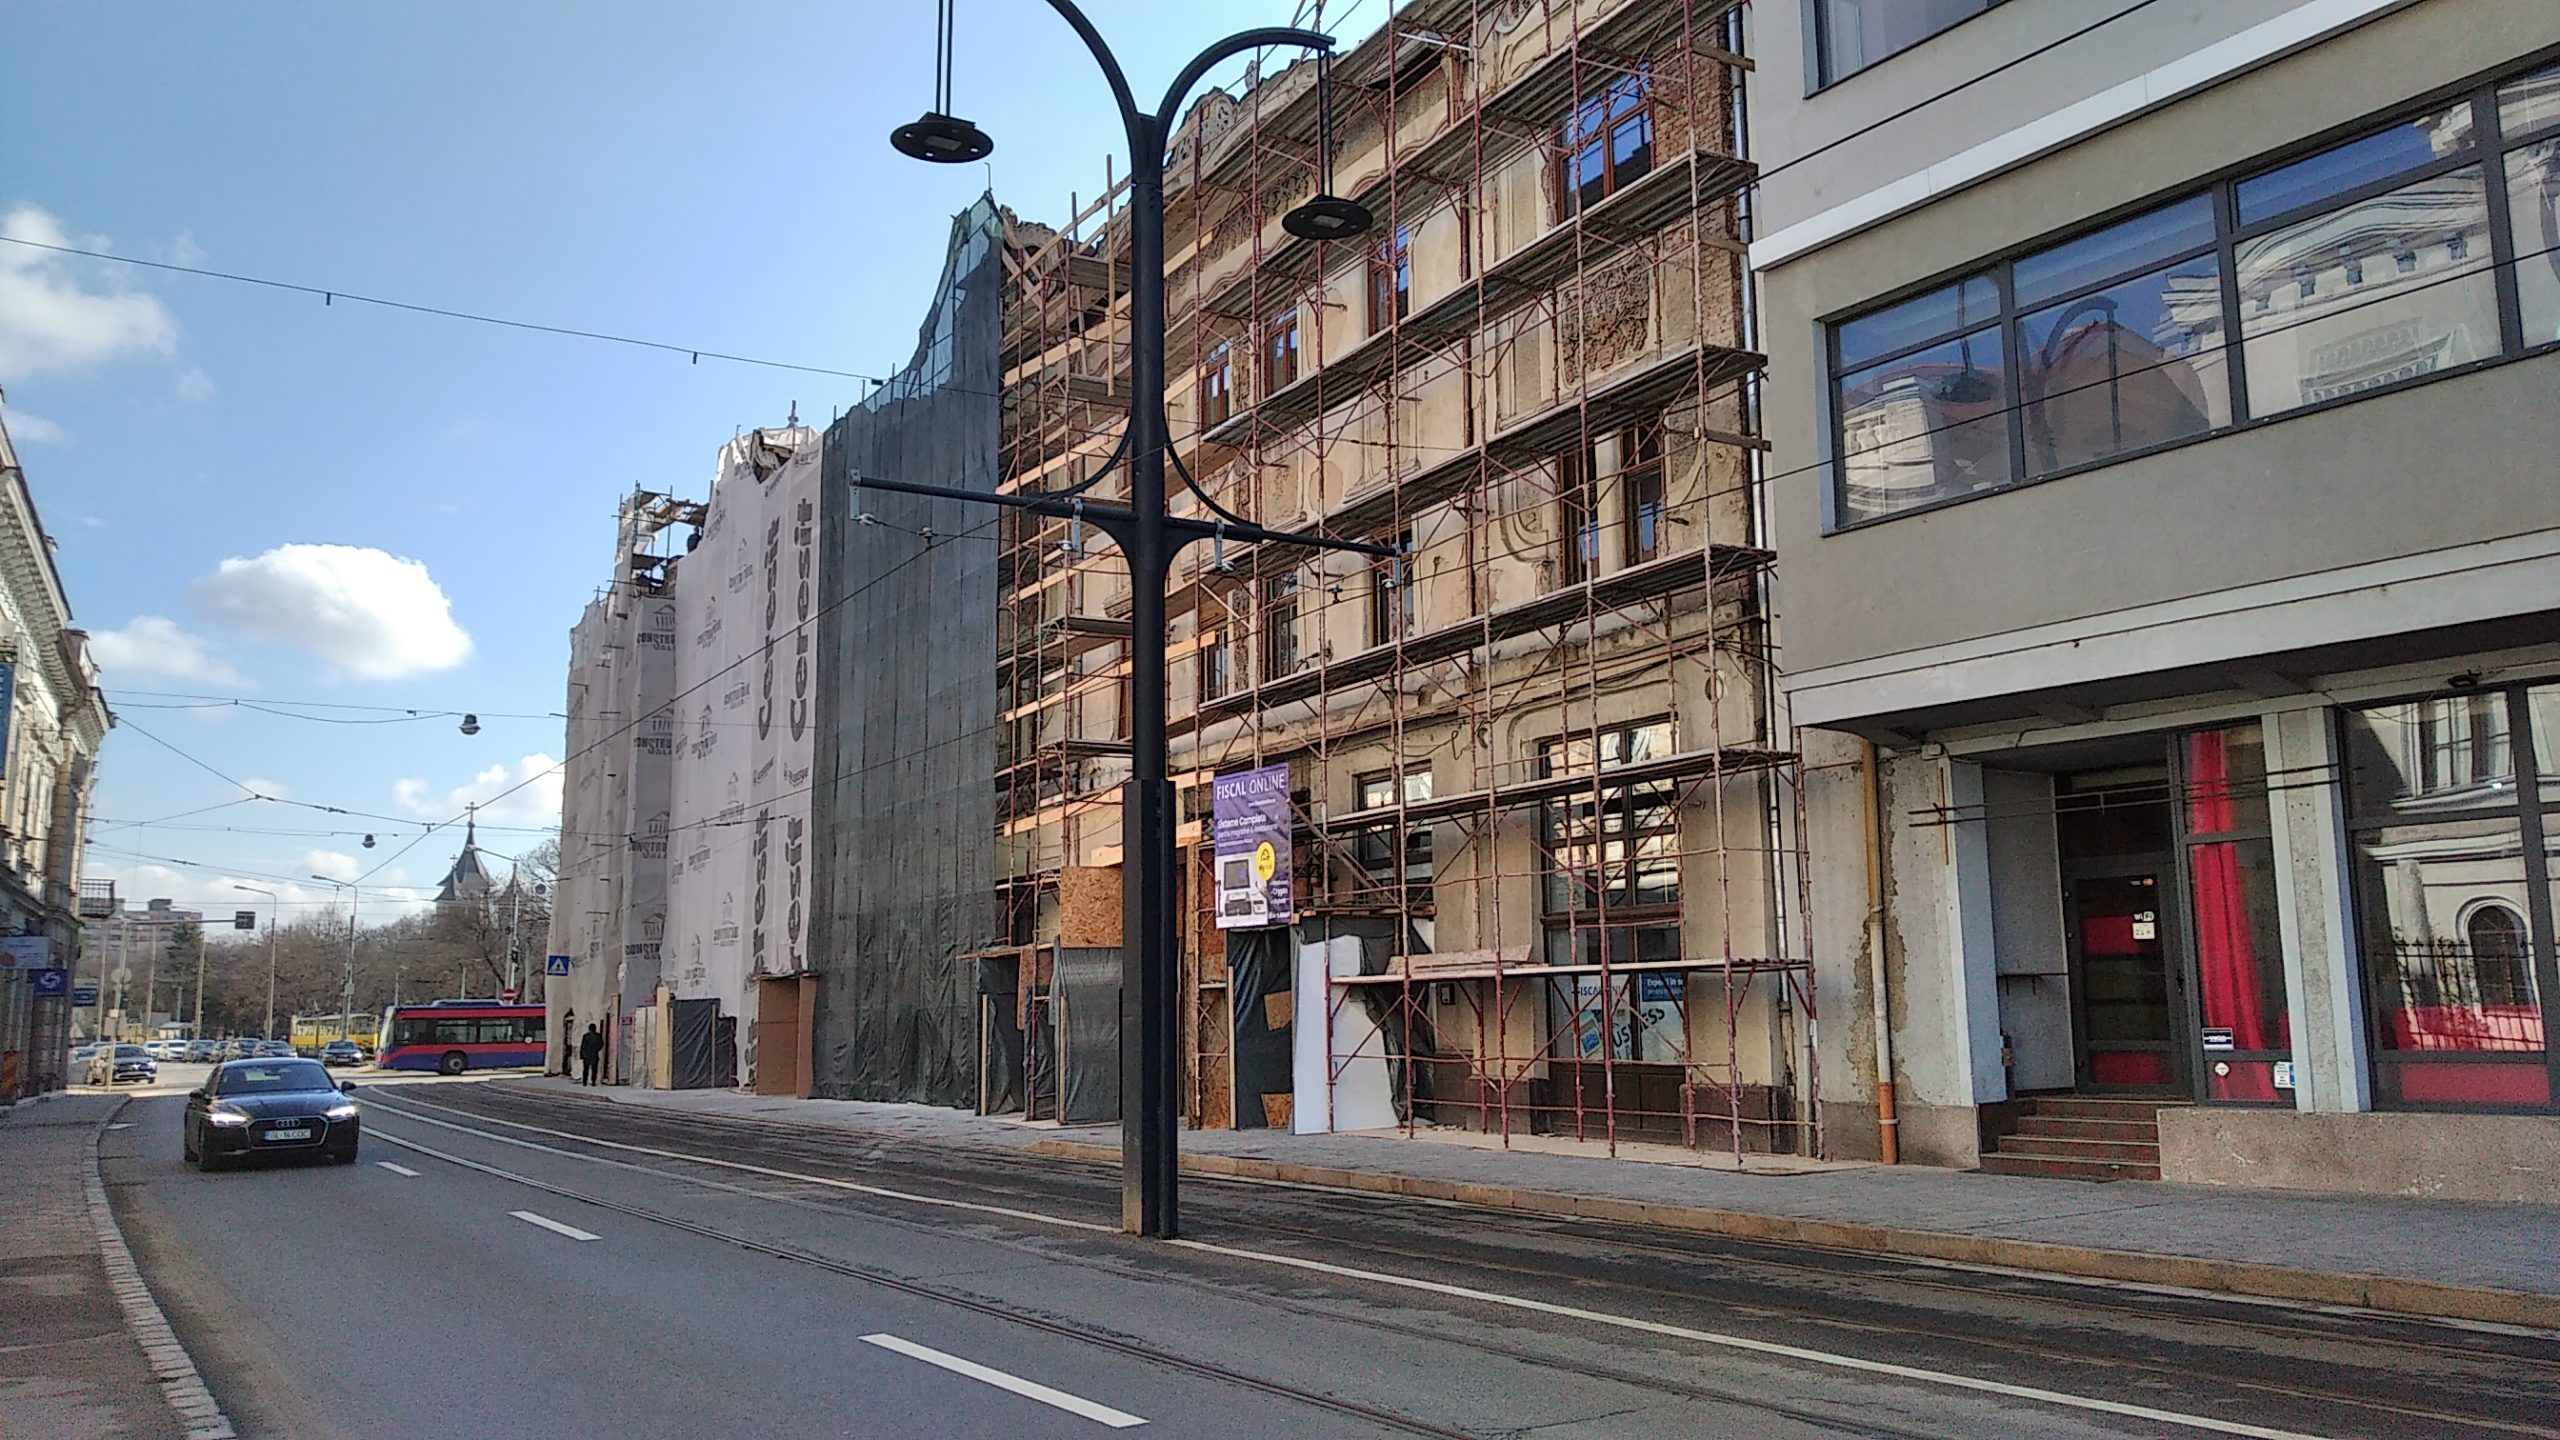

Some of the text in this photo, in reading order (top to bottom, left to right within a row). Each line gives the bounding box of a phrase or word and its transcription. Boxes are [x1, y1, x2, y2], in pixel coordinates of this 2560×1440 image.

[758, 516, 781, 742] Ceresit
[789, 498, 814, 743] Ceresit
[1216, 773, 1285, 800] FISCAL ONLINE
